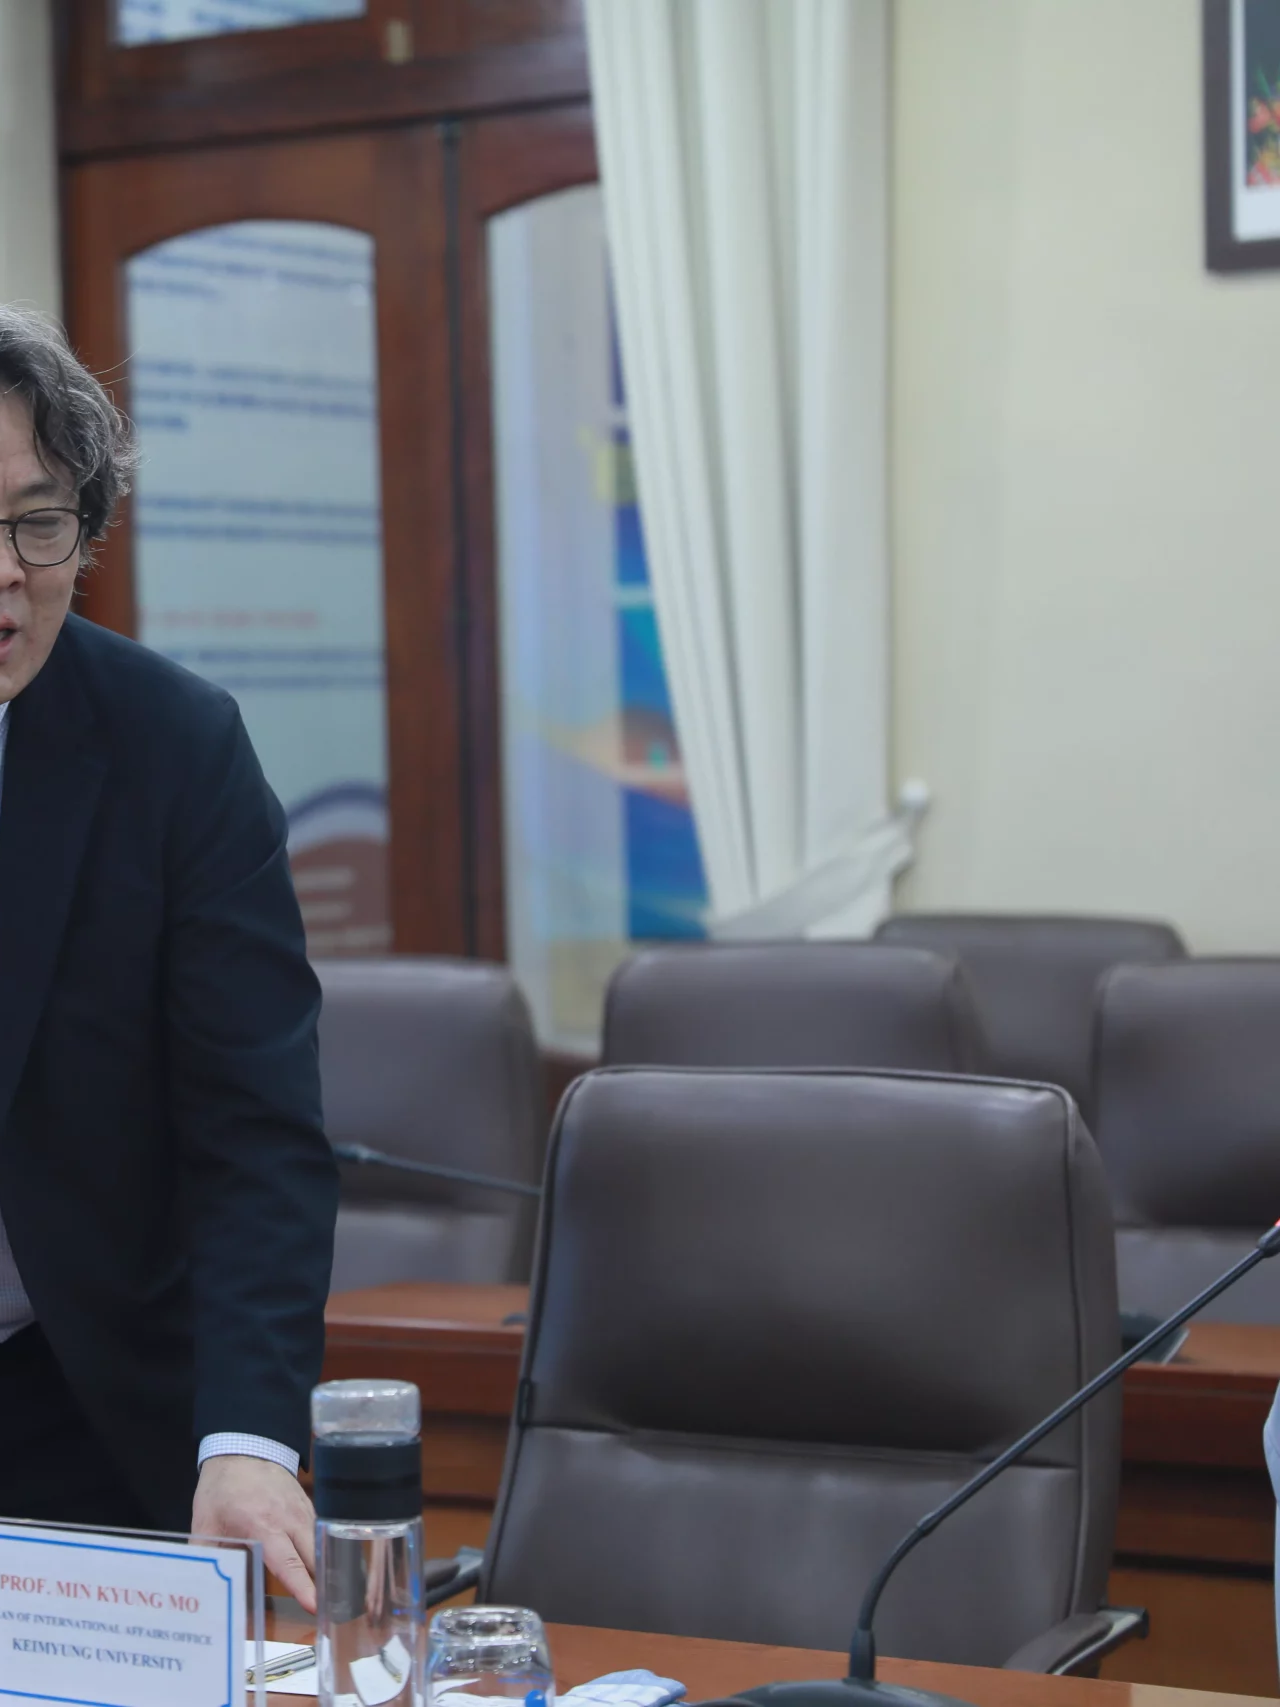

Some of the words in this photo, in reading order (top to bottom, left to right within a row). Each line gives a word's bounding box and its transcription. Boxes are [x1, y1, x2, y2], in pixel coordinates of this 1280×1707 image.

[0, 1574, 51, 1596] PROF.
[56, 1580, 91, 1599] MIN
[97, 1585, 163, 1609] KYUNG
[168, 1594, 199, 1613] MO
[16, 1612, 32, 1623] OF
[34, 1614, 120, 1635] INTERNATIONAL
[125, 1626, 170, 1641] AFFAIRS
[171, 1632, 213, 1646] OFFICE
[12, 1638, 92, 1661] KEIMYUNG
[96, 1648, 184, 1672] UNIVERSITY
